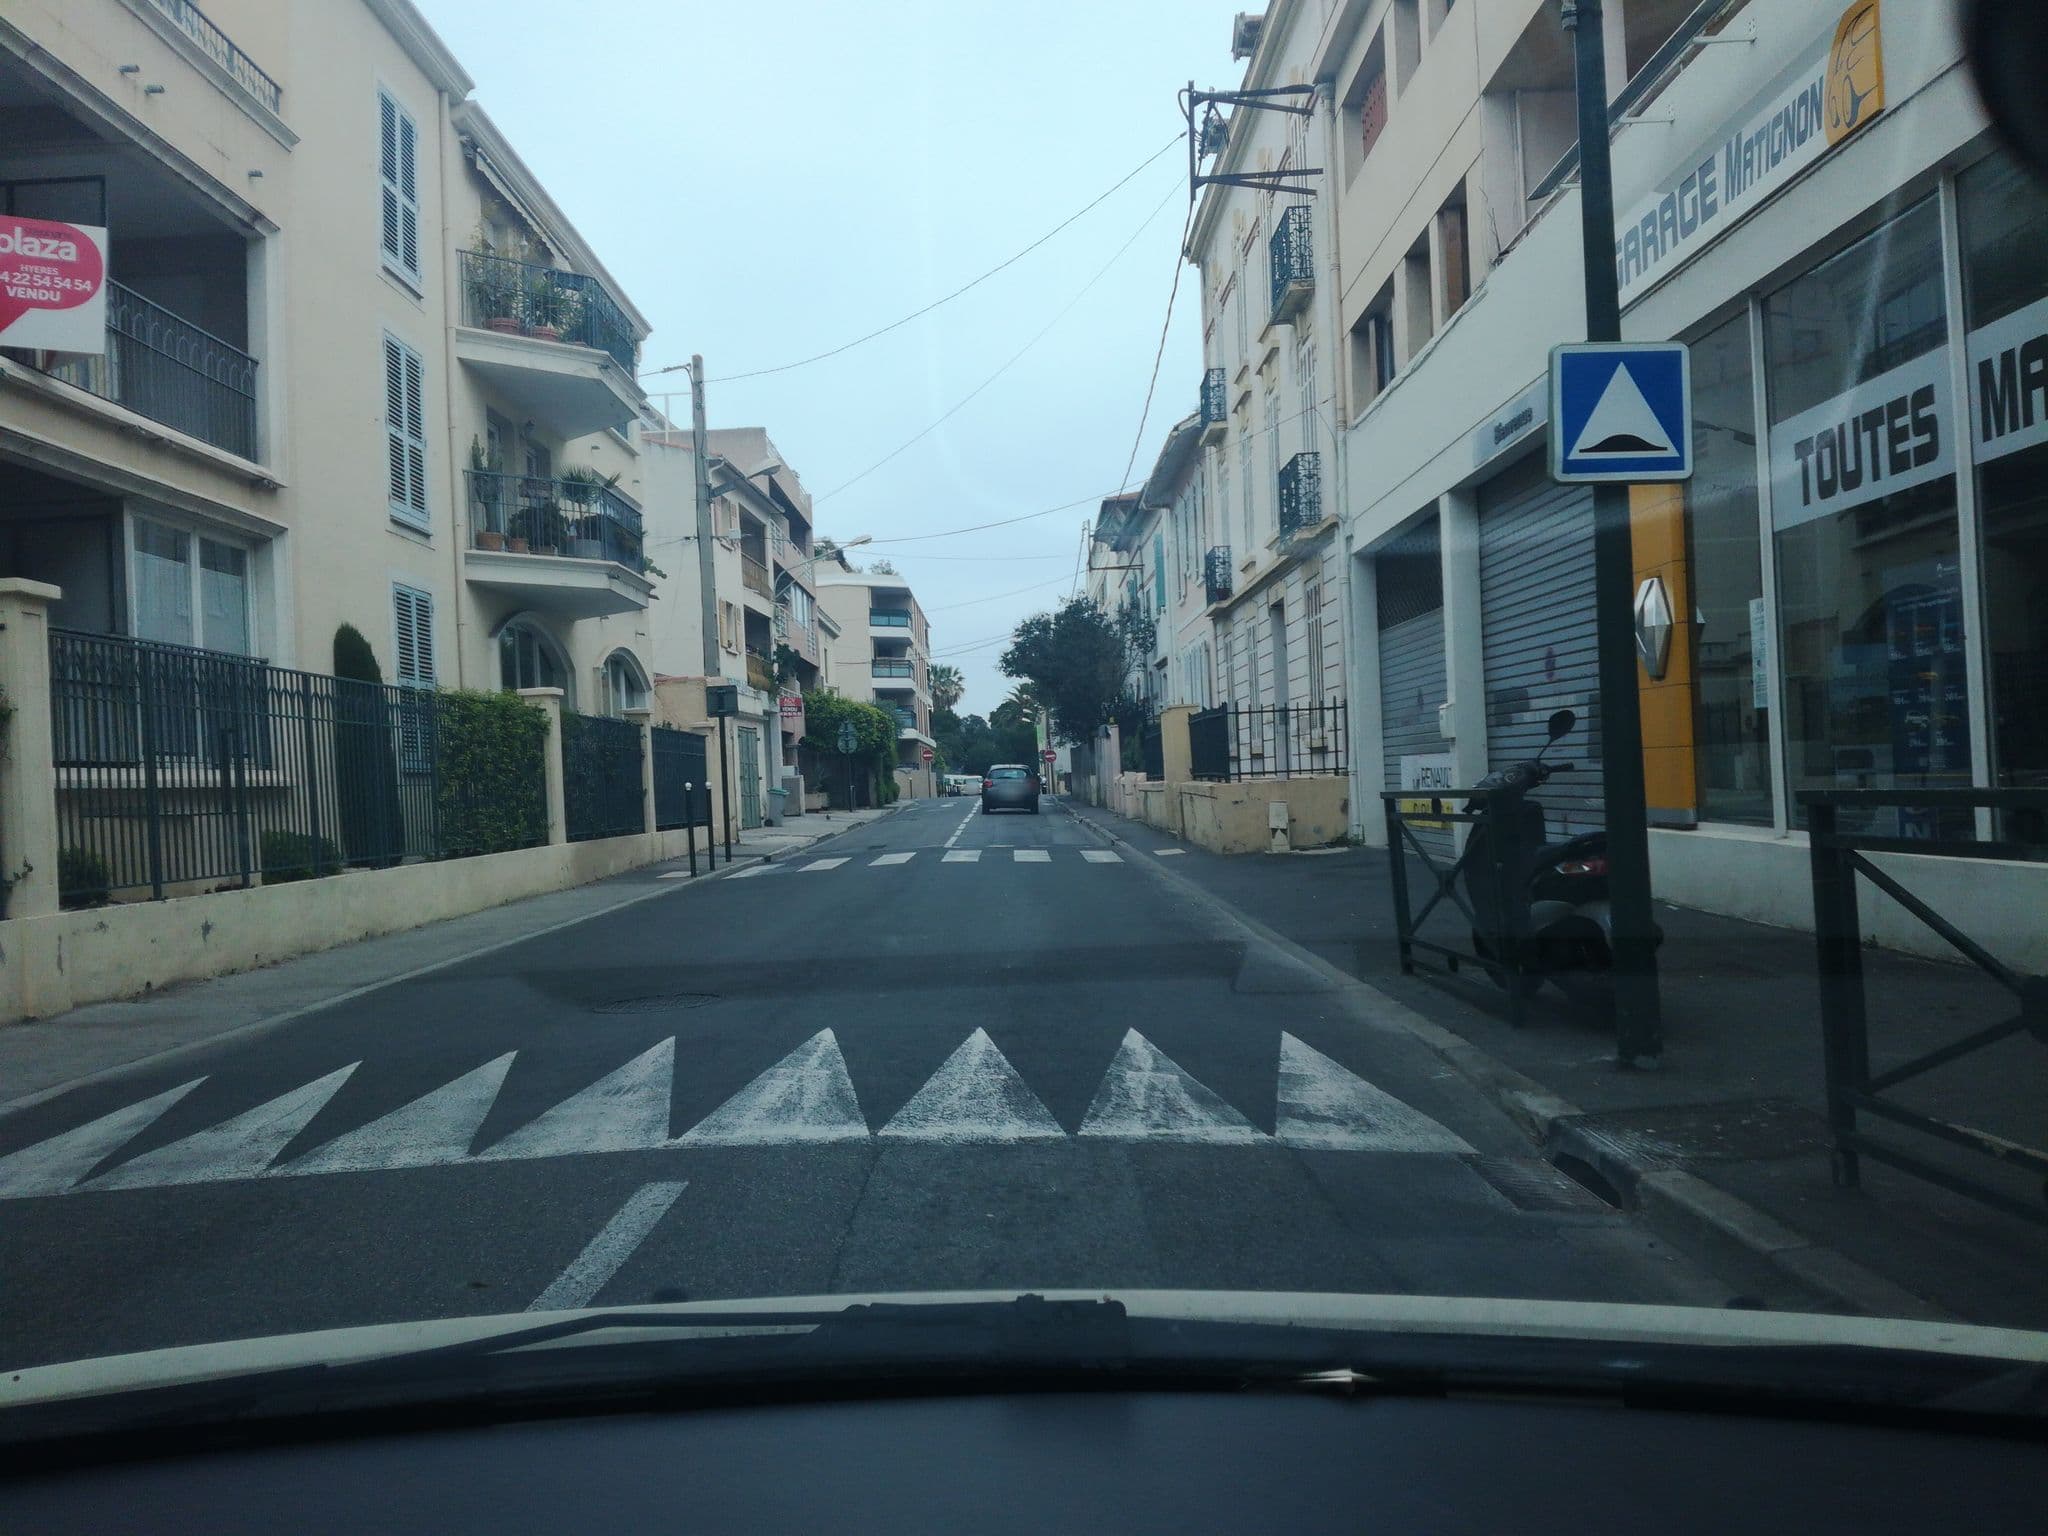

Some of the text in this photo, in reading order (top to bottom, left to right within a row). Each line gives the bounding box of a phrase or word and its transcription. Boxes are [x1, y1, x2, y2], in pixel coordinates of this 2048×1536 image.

[1724, 75, 1824, 205] MATIGNON
[5, 285, 61, 302] VENDU
[12, 272, 30, 285] 22
[33, 274, 52, 287] 54
[53, 277, 73, 290] 54
[74, 279, 92, 292] 54
[1794, 383, 1940, 506] TOUTES
